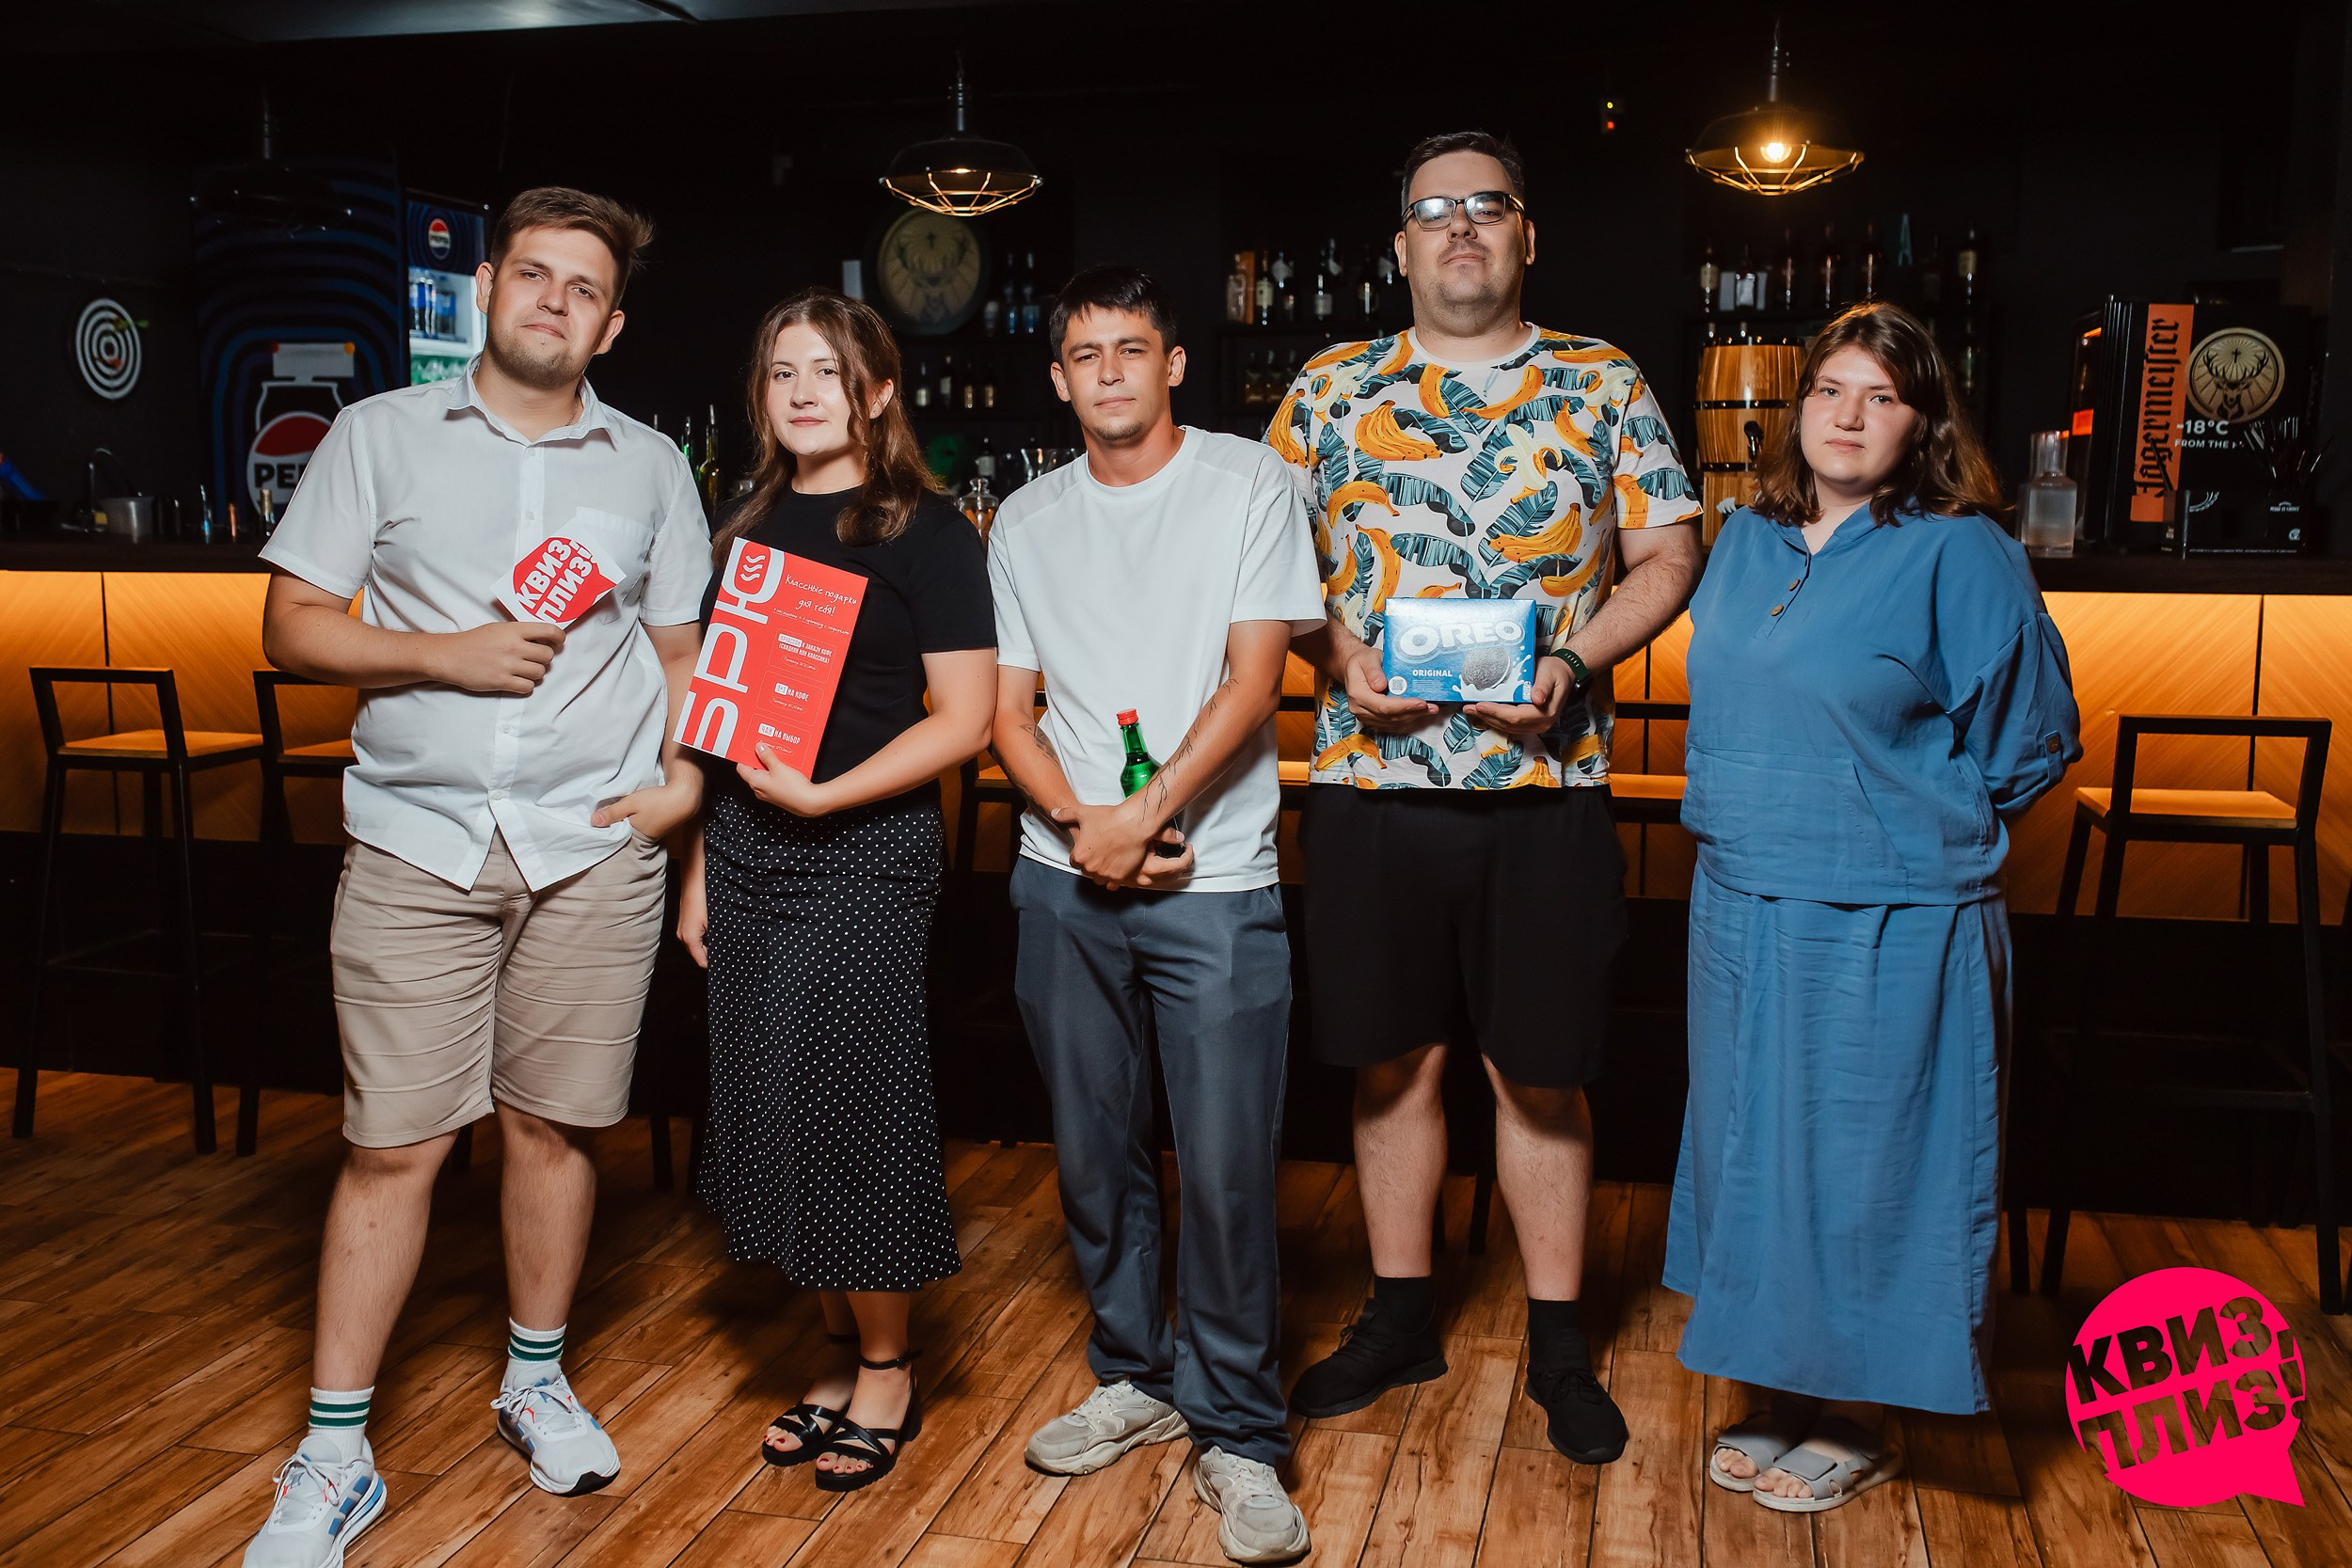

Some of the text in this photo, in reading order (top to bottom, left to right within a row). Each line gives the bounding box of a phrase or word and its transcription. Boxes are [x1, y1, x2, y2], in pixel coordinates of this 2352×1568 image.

[2176, 420, 2230, 435] -18°C
[2174, 439, 2205, 448] FROM
[2208, 440, 2230, 449] THE
[785, 574, 857, 604] Классные подарки
[796, 599, 836, 616] для тебя!
[1398, 620, 1523, 657] OREO
[1412, 669, 1453, 677] ORIGINAL
[787, 688, 795, 697] НА
[795, 691, 809, 702] КОФЕ
[774, 730, 782, 738] НА
[783, 733, 801, 745] ВЫБОР
